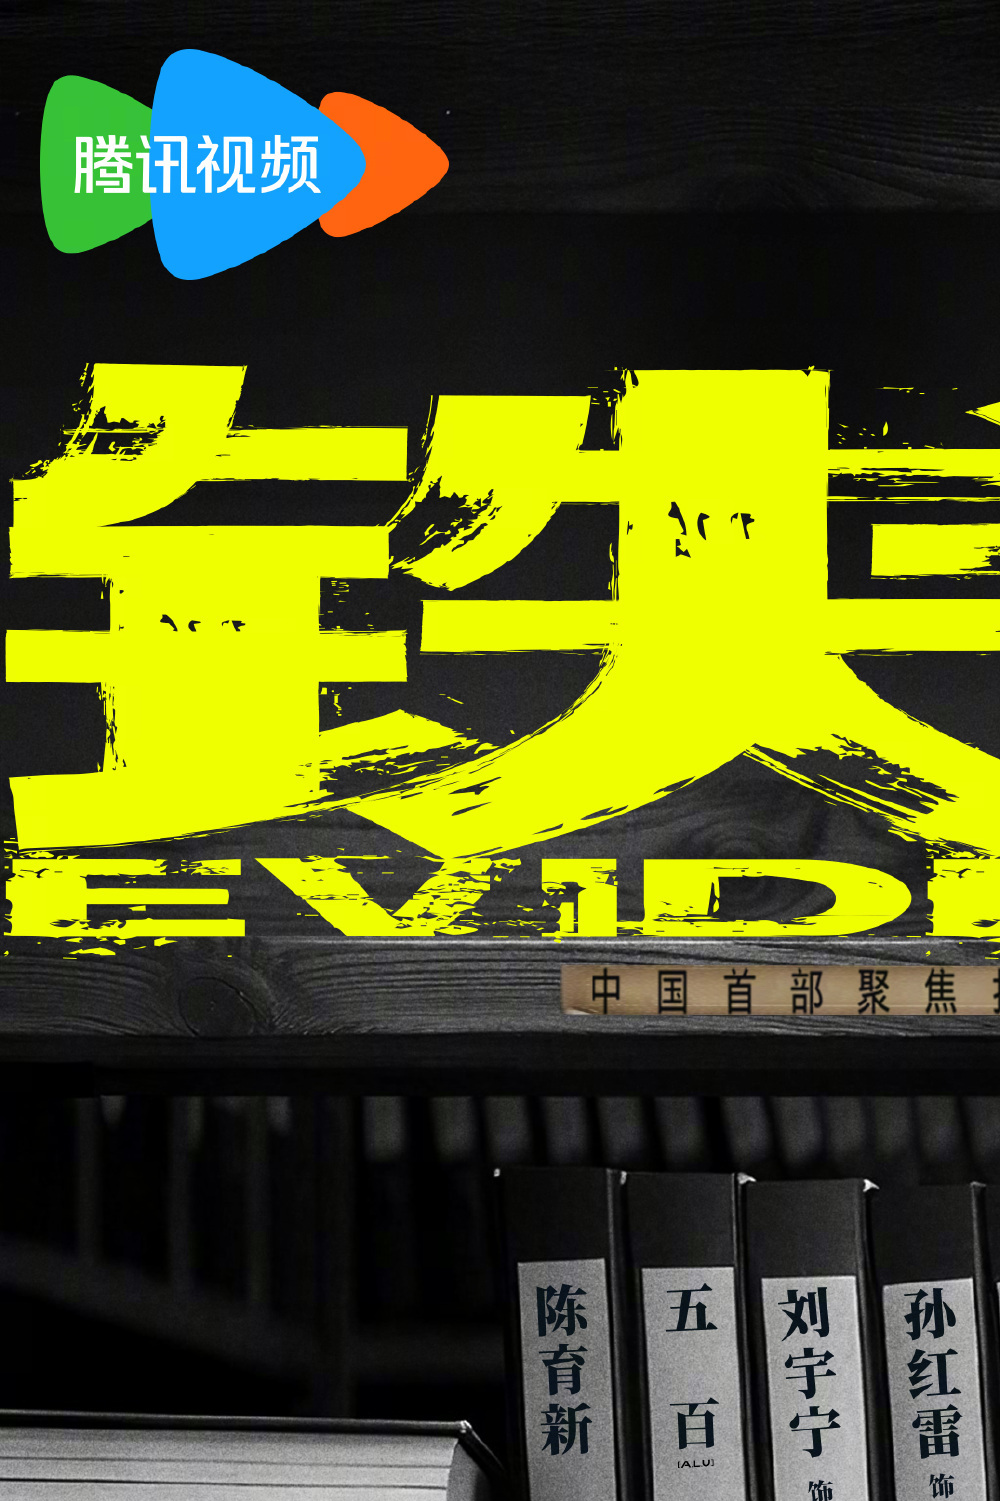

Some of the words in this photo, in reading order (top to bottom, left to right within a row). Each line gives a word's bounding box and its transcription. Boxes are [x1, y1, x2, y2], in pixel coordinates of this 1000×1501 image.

[74, 134, 322, 194] 腾讯视频
[537, 1284, 592, 1455] 陈育新
[666, 1283, 719, 1449] 五百
[778, 1287, 840, 1458] 刘宇宁
[904, 1288, 962, 1459] 孙红雷
[929, 1474, 954, 1498] 饰
